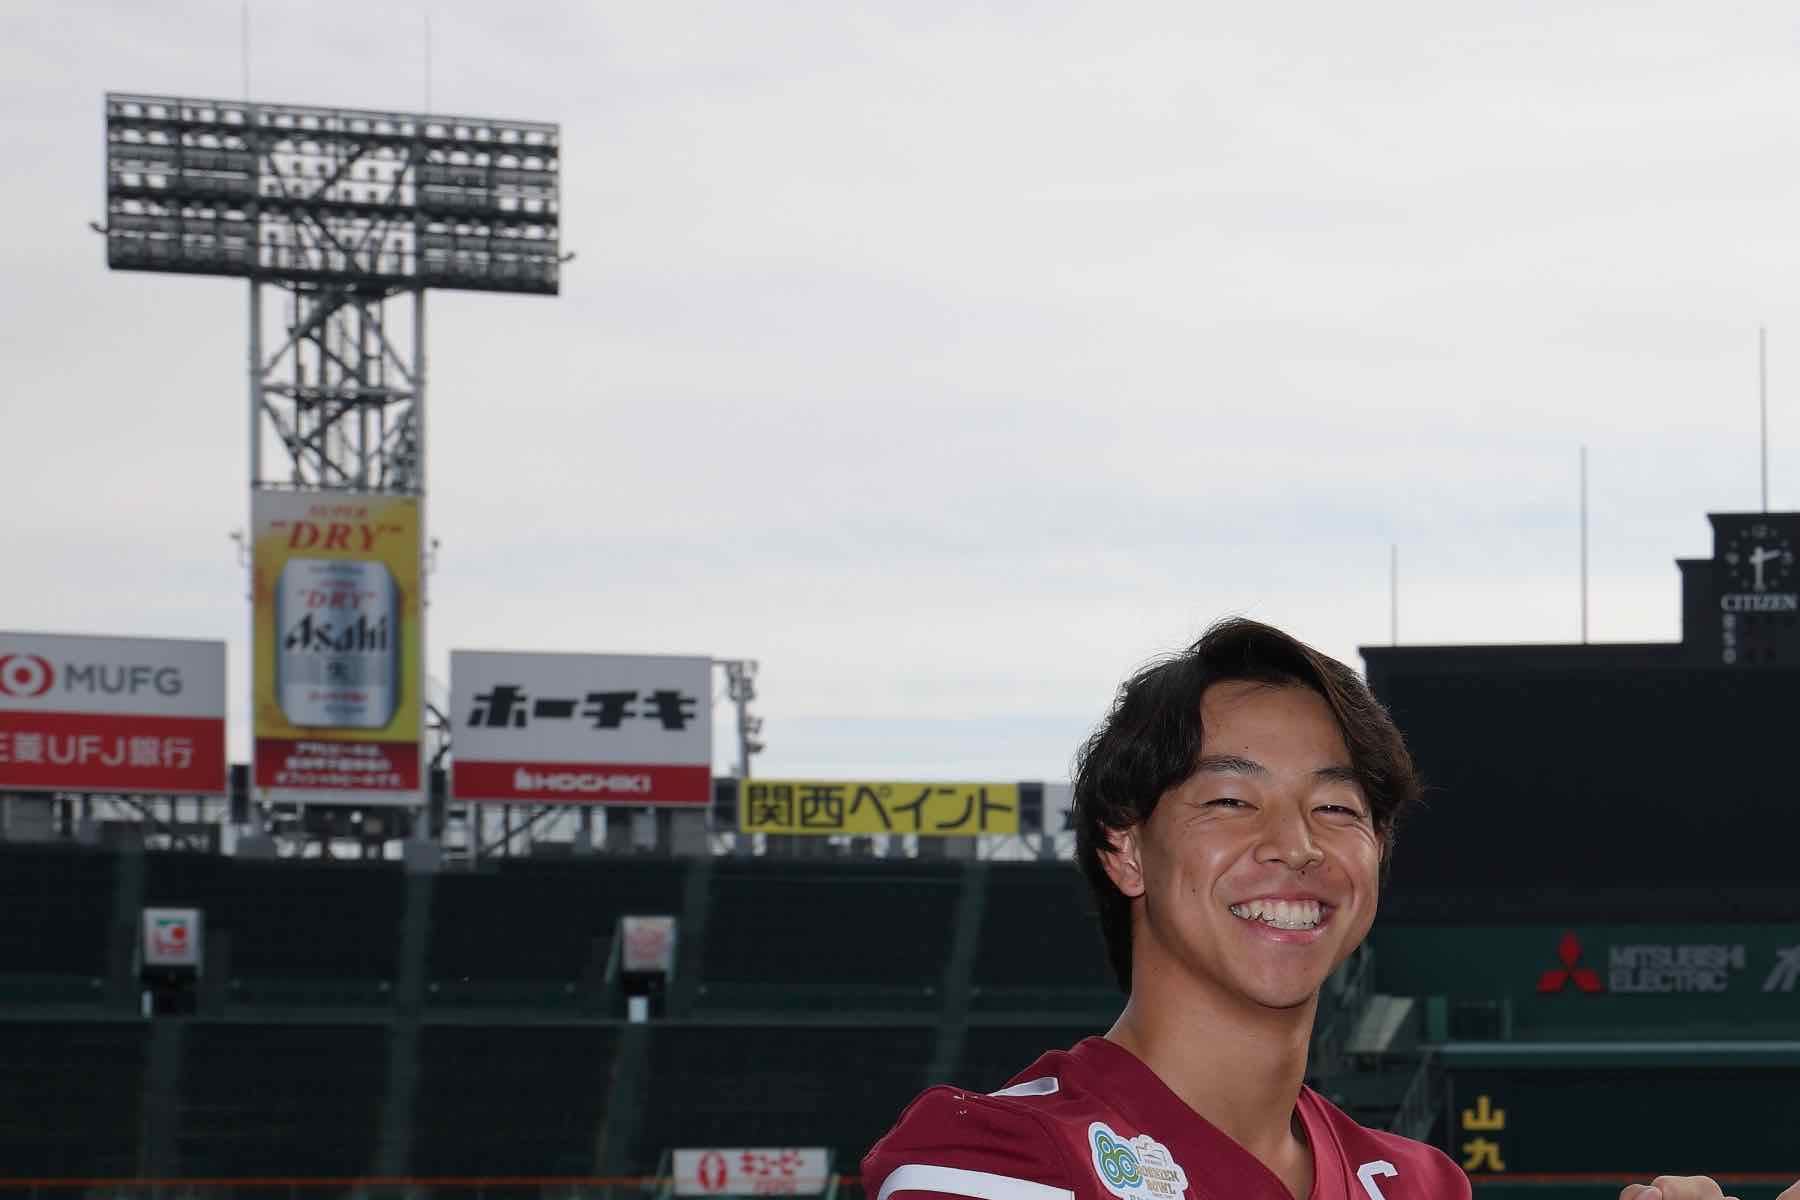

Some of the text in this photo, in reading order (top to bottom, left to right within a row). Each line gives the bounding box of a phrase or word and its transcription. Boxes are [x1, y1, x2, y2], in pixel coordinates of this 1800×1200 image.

[1720, 593, 1798, 612] CITIZEN
[284, 612, 388, 653] Asahi
[64, 663, 183, 697] MUFG
[467, 684, 697, 731] ホーチキ
[747, 784, 1013, 830] 関西ペイント
[1608, 945, 1745, 968] MITSUBISHI
[1608, 969, 1728, 992] ELECTRIC
[1461, 1094, 1505, 1171] 山九
